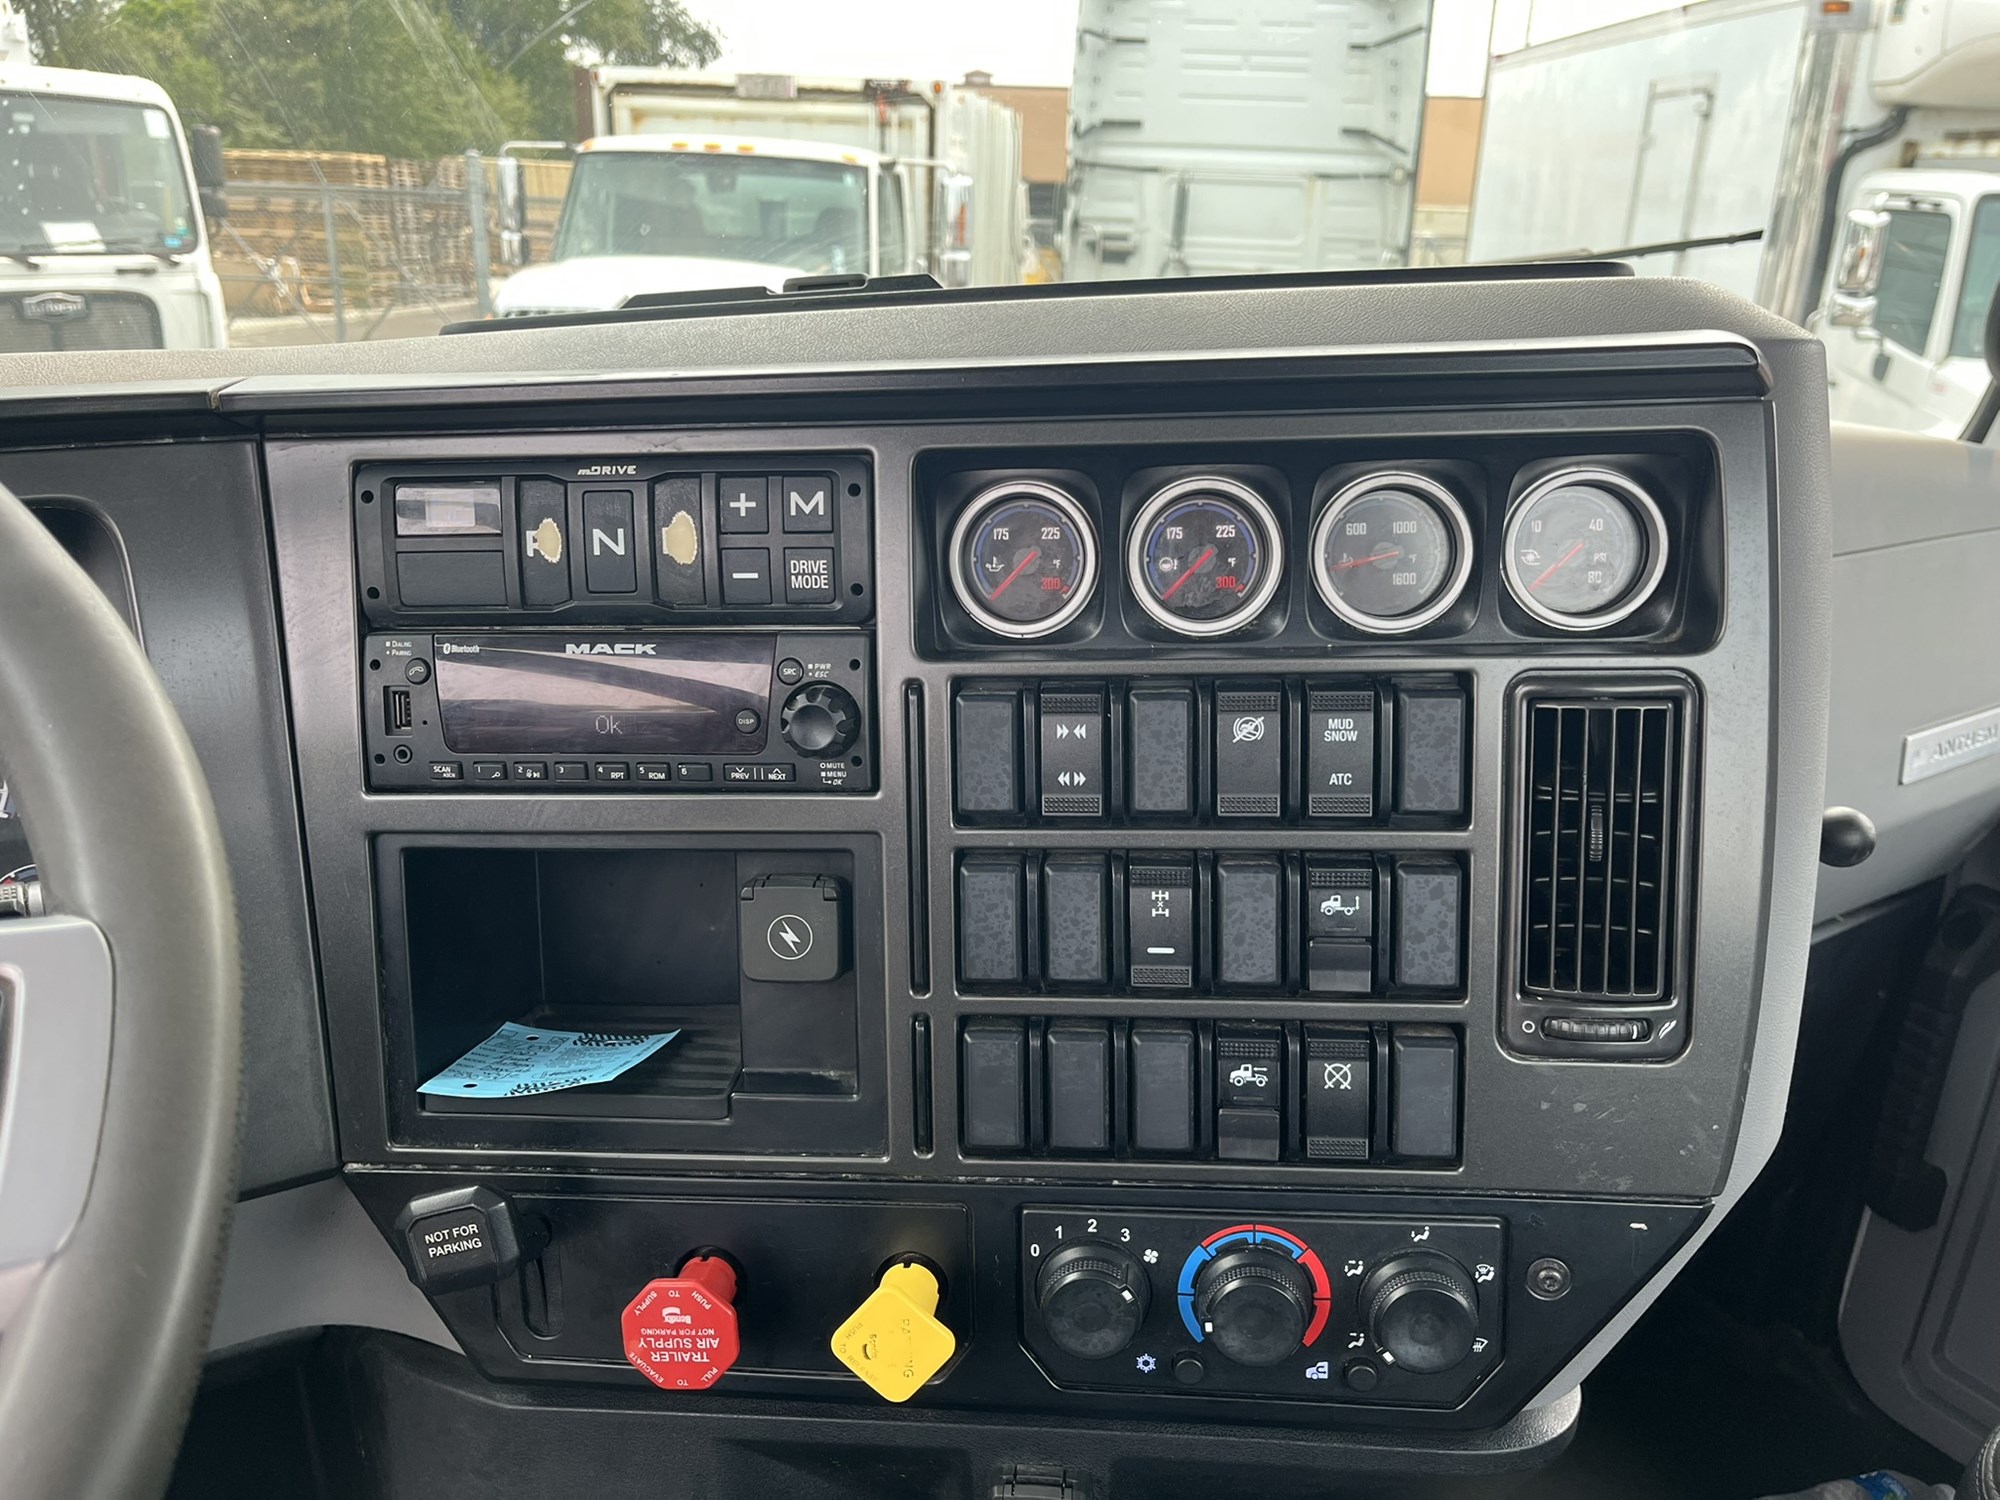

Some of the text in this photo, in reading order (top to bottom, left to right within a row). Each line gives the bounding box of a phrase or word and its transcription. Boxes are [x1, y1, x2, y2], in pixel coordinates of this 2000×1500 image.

[577, 465, 637, 476] mDRIVE
[790, 491, 825, 516] M
[1346, 523, 1367, 535] 600
[1392, 521, 1417, 534] 1000
[1531, 520, 1542, 533] 10
[1589, 518, 1604, 531] 40
[993, 528, 1009, 540] 175
[1041, 527, 1060, 539] 225
[1166, 527, 1183, 540] 175
[1215, 525, 1236, 538] 225
[592, 528, 625, 556] N
[1593, 553, 1607, 562] PSI
[790, 560, 828, 574] DRIVE
[791, 575, 829, 589] MODE
[1041, 577, 1060, 590] 300
[1215, 576, 1236, 589] 300
[1392, 572, 1417, 586] 1600
[1587, 571, 1602, 584] 80
[451, 645, 480, 653] Bluetooth
[565, 643, 657, 655] MACK
[1328, 718, 1354, 730] MUD
[1324, 730, 1358, 742] SNOW
[433, 765, 451, 773] SCAN
[559, 766, 564, 774] 3
[826, 770, 847, 778] MENU
[648, 772, 666, 780] RDM
[731, 772, 750, 780] PREV
[768, 772, 786, 780] NEXT
[1329, 773, 1353, 785] ATC
[1054, 1226, 1063, 1239] 1
[1087, 1219, 1098, 1233] 2
[424, 1223, 479, 1244] NOT FOR
[1120, 1228, 1131, 1242] 3
[428, 1238, 482, 1258] PARKING
[1030, 1244, 1040, 1257] 0
[634, 1290, 658, 1316] SUPPLY
[691, 1291, 712, 1310] PUSH
[638, 1338, 720, 1349] AIR SUPPLY
[650, 1352, 711, 1363] TRAILER
[629, 1352, 664, 1383] EVACUATE
[700, 1366, 719, 1382] PULL
